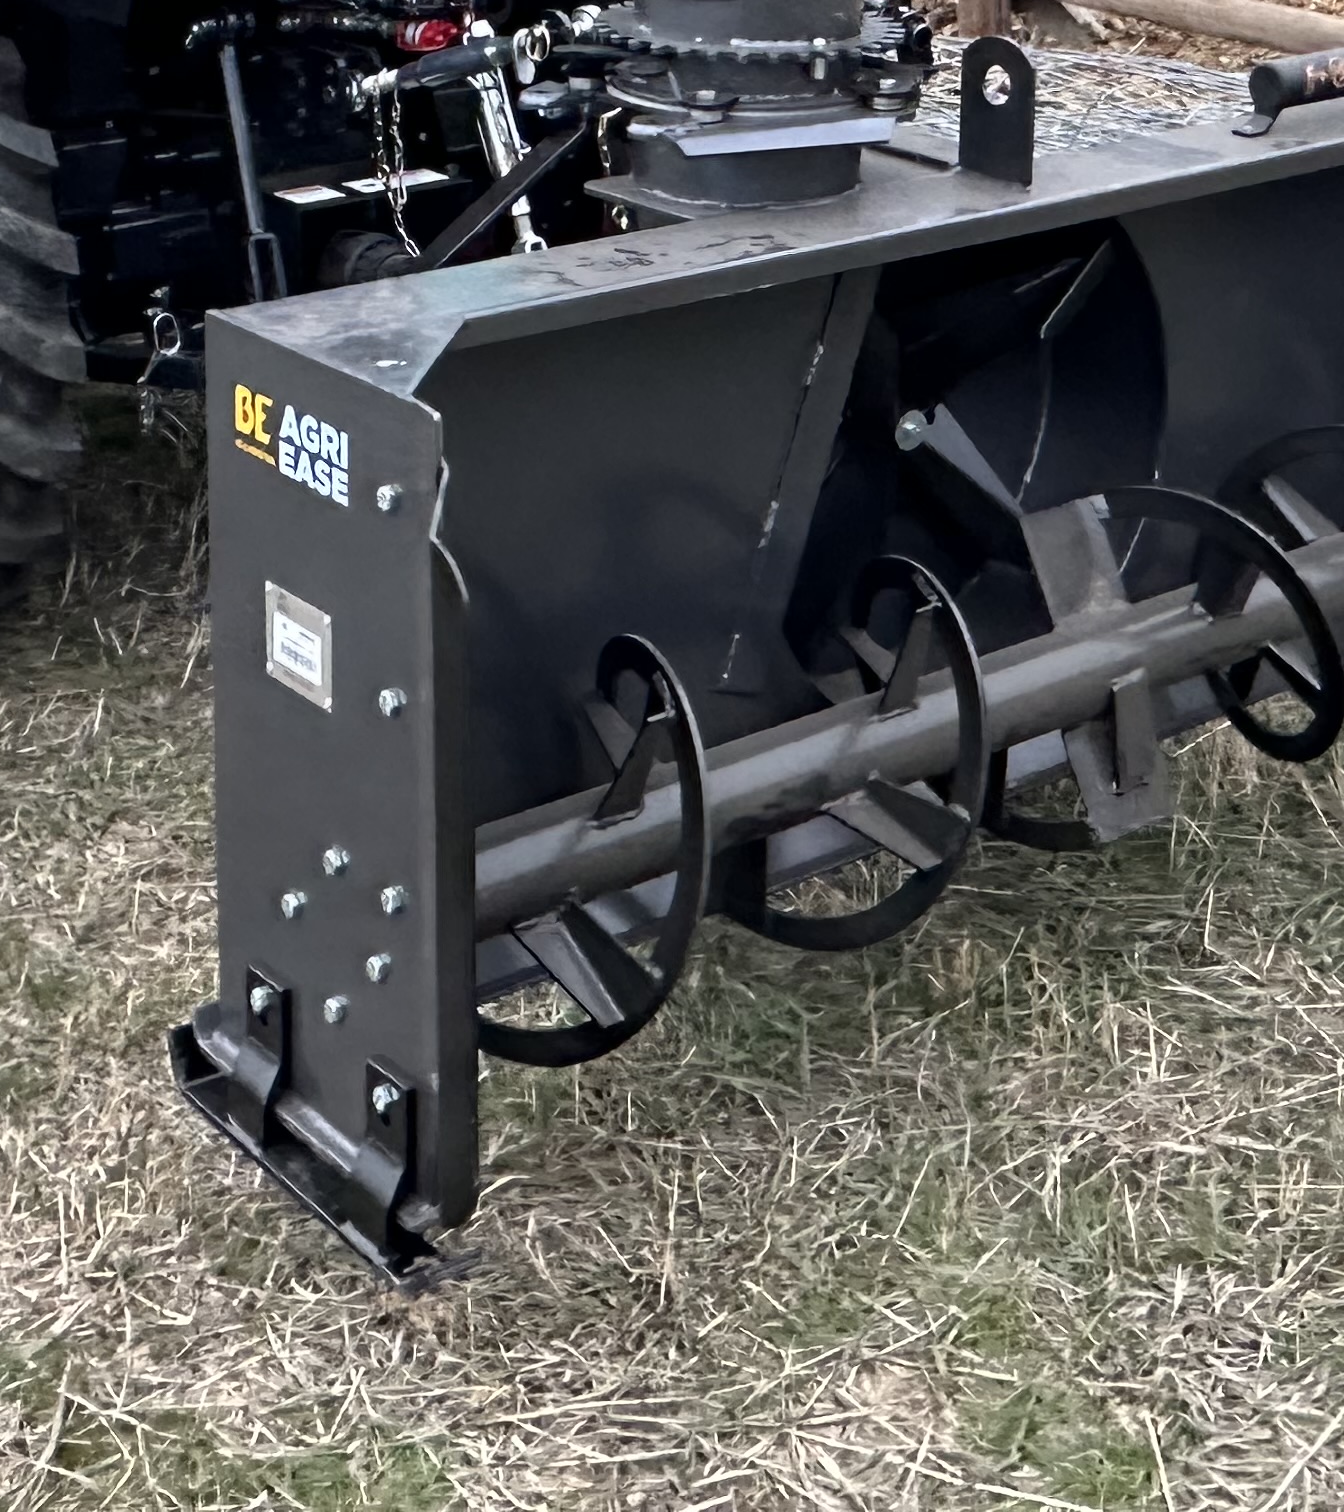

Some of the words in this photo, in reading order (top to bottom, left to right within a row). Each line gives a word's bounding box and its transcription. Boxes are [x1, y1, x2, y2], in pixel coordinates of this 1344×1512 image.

[234, 383, 274, 445] BE
[278, 404, 349, 470] AGRI
[278, 439, 349, 507] EASE
